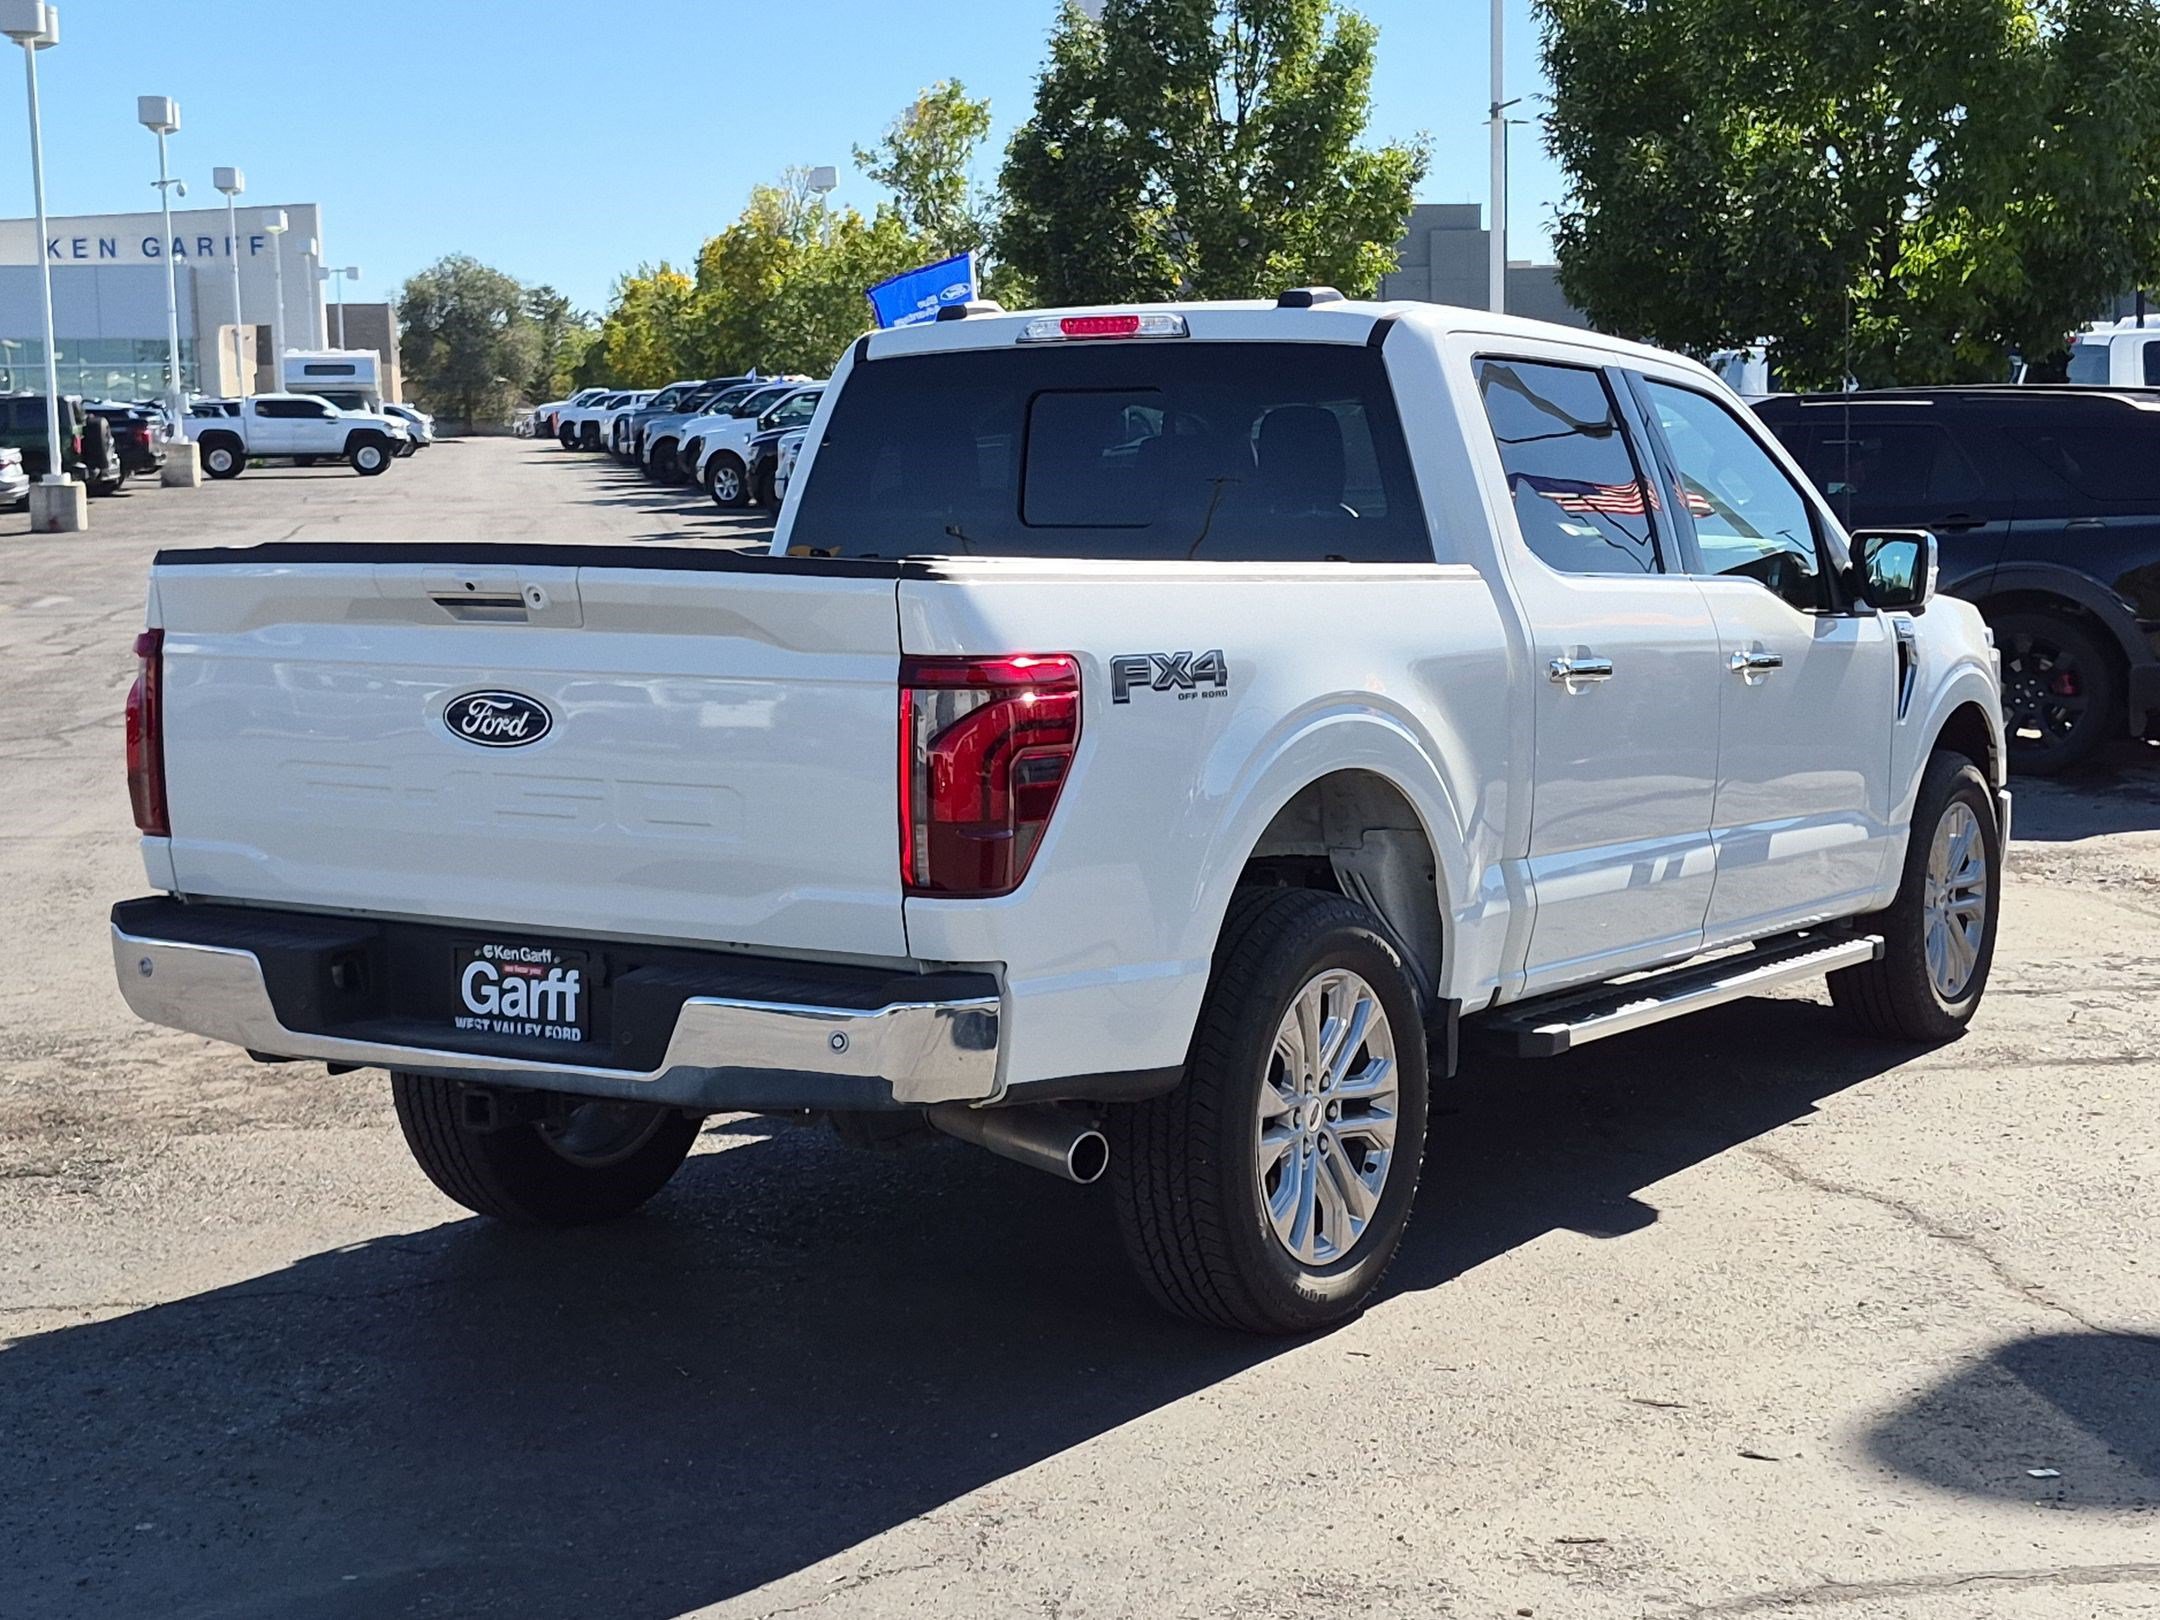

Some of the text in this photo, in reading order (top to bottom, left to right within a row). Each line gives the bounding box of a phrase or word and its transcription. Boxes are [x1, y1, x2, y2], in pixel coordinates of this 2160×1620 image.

[47, 236, 265, 259] KEN GARFF
[1110, 649, 1228, 704] FX4
[1178, 690, 1228, 700] OFF ROAD
[461, 698, 529, 738] Ford
[495, 945, 552, 963] Ken Garff
[461, 960, 580, 1022] Garff
[455, 1016, 581, 1042] WEST VALLEY FORD
